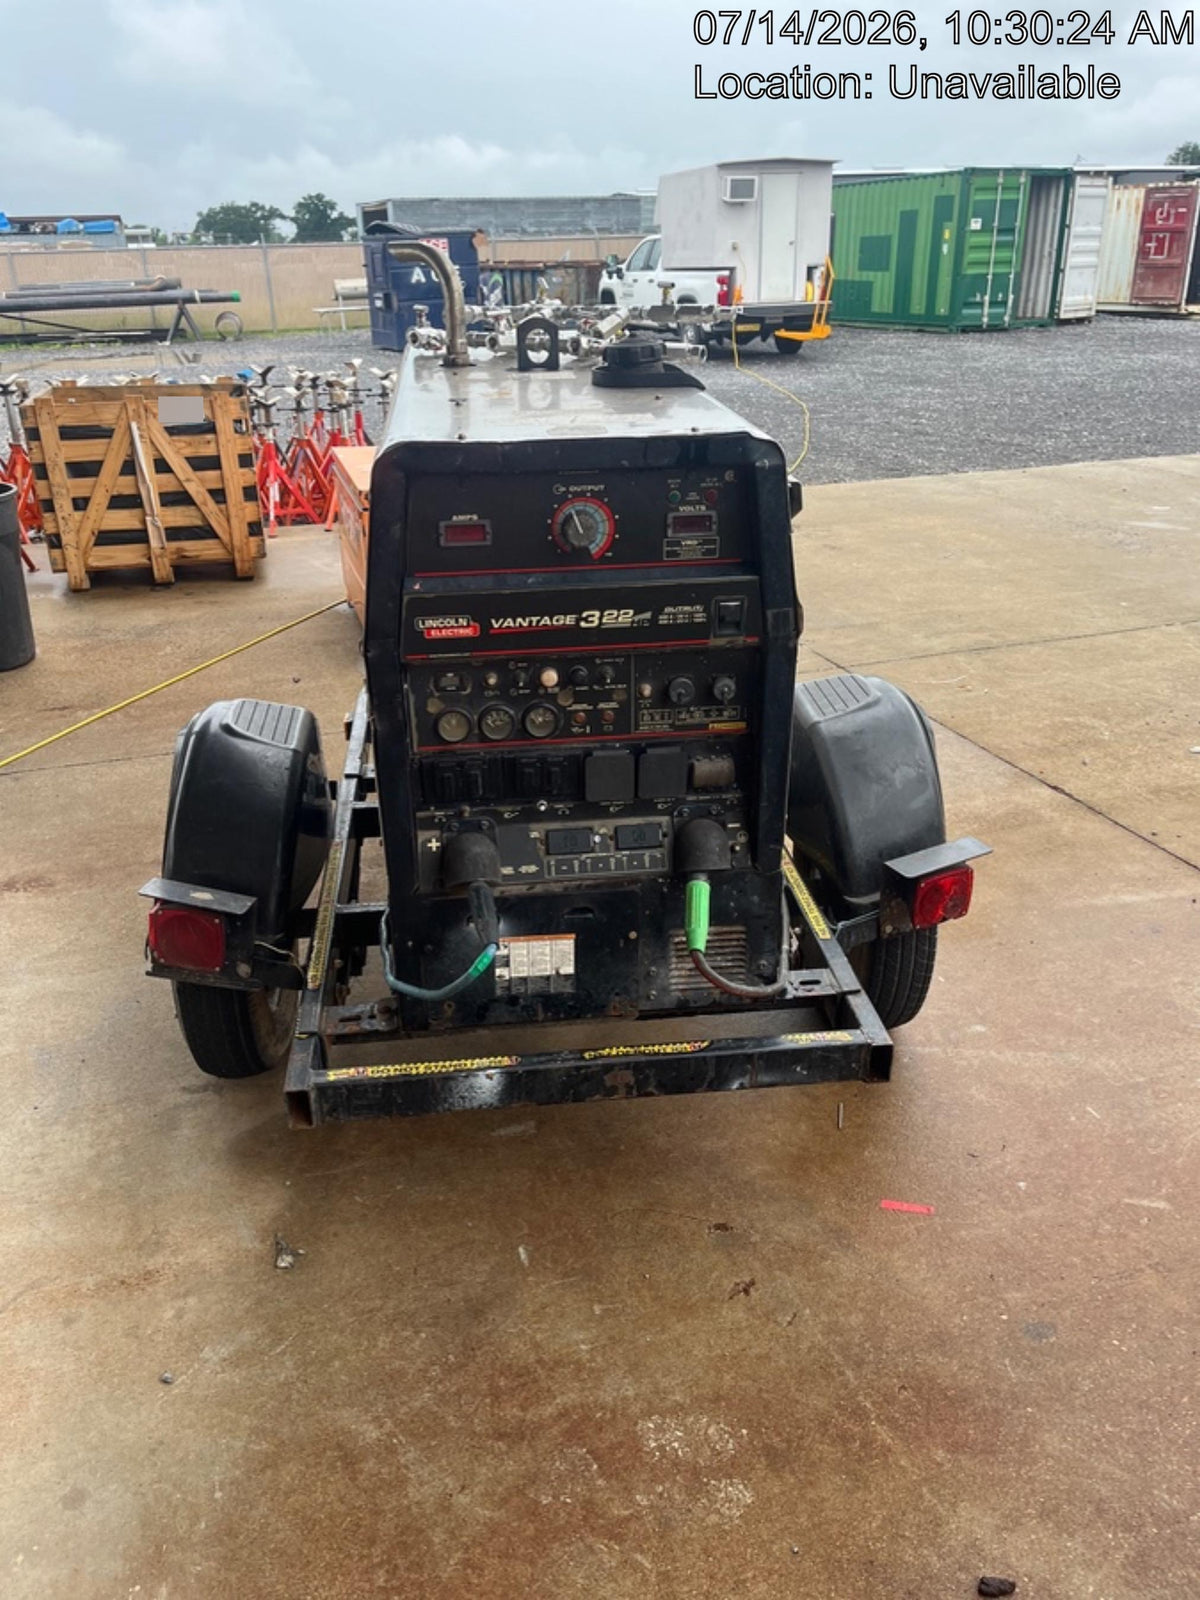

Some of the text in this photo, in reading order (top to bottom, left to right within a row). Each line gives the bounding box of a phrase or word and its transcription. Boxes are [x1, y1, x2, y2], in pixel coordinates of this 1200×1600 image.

[418, 617, 468, 629] LINCOLN
[490, 614, 576, 629] VANTAGE
[579, 609, 634, 628] 322
[431, 627, 473, 638] ELECTRIC
